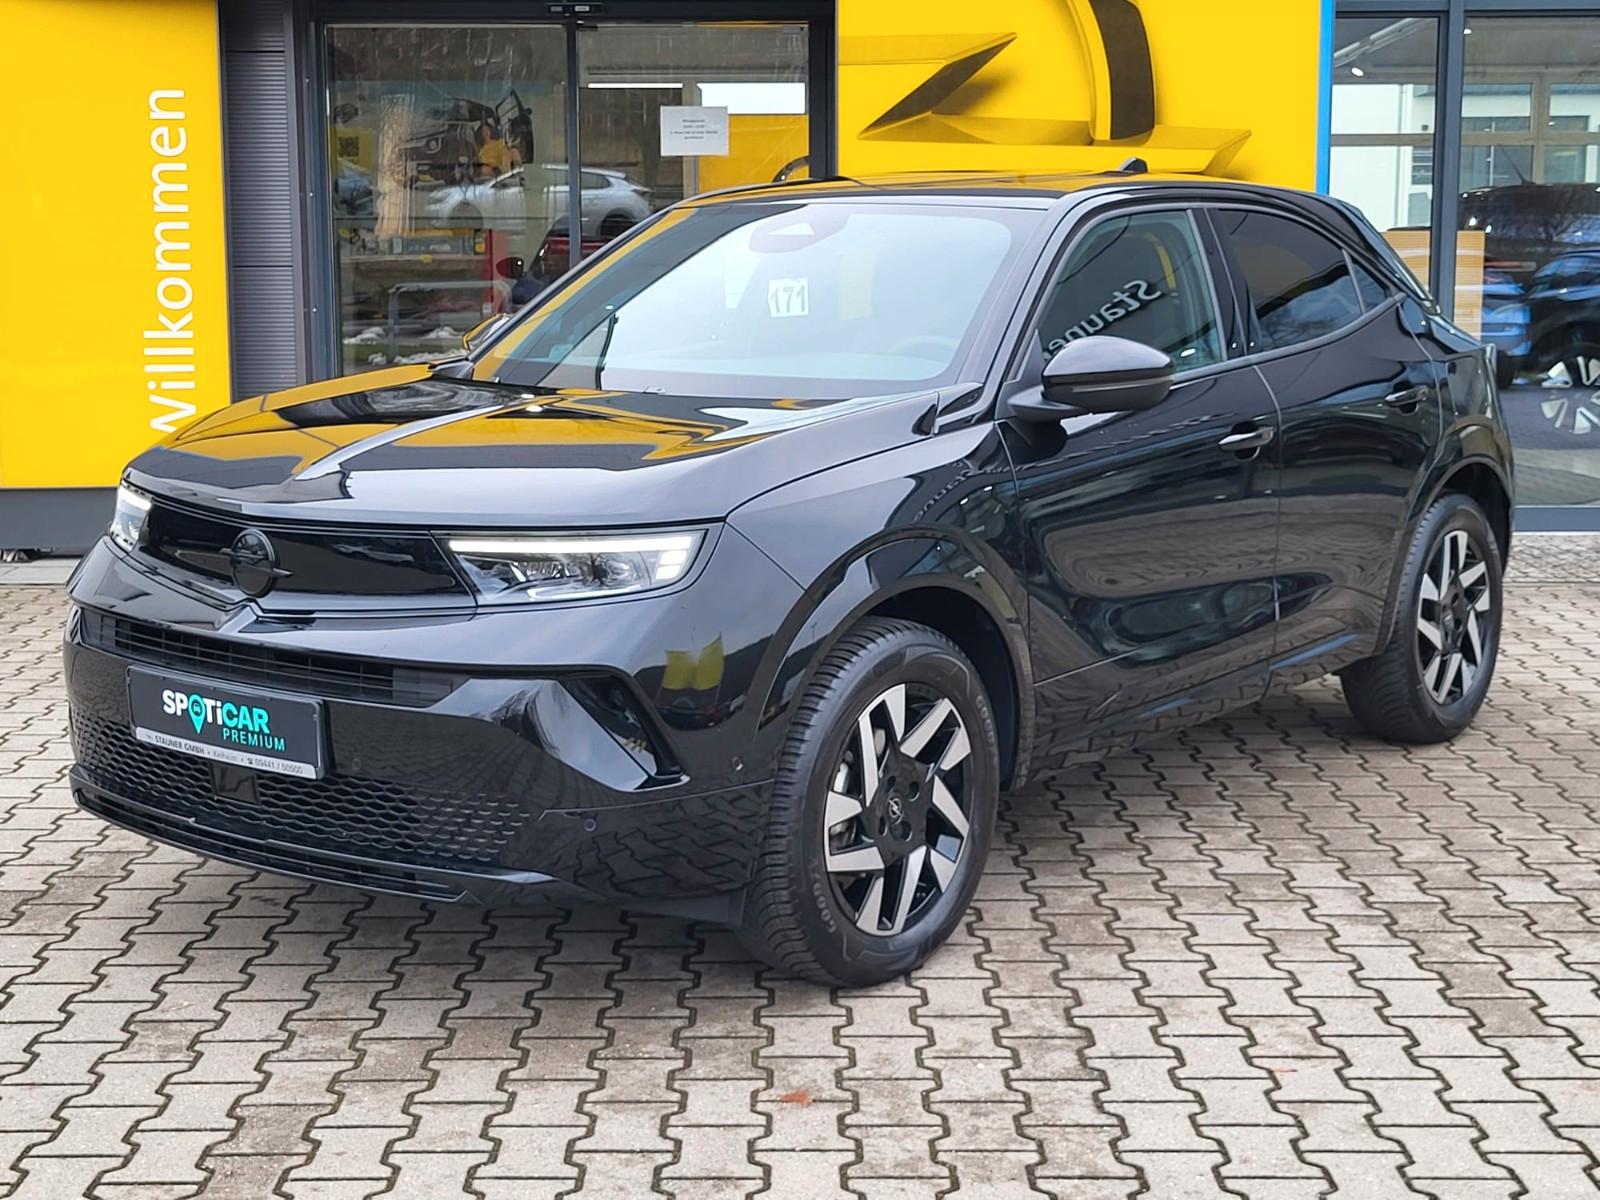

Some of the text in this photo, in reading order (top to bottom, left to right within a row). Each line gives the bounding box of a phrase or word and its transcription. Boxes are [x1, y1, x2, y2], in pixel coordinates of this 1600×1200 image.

[143, 88, 197, 433] Willkommen
[770, 285, 806, 314] 171
[222, 727, 286, 751] PREMIUM
